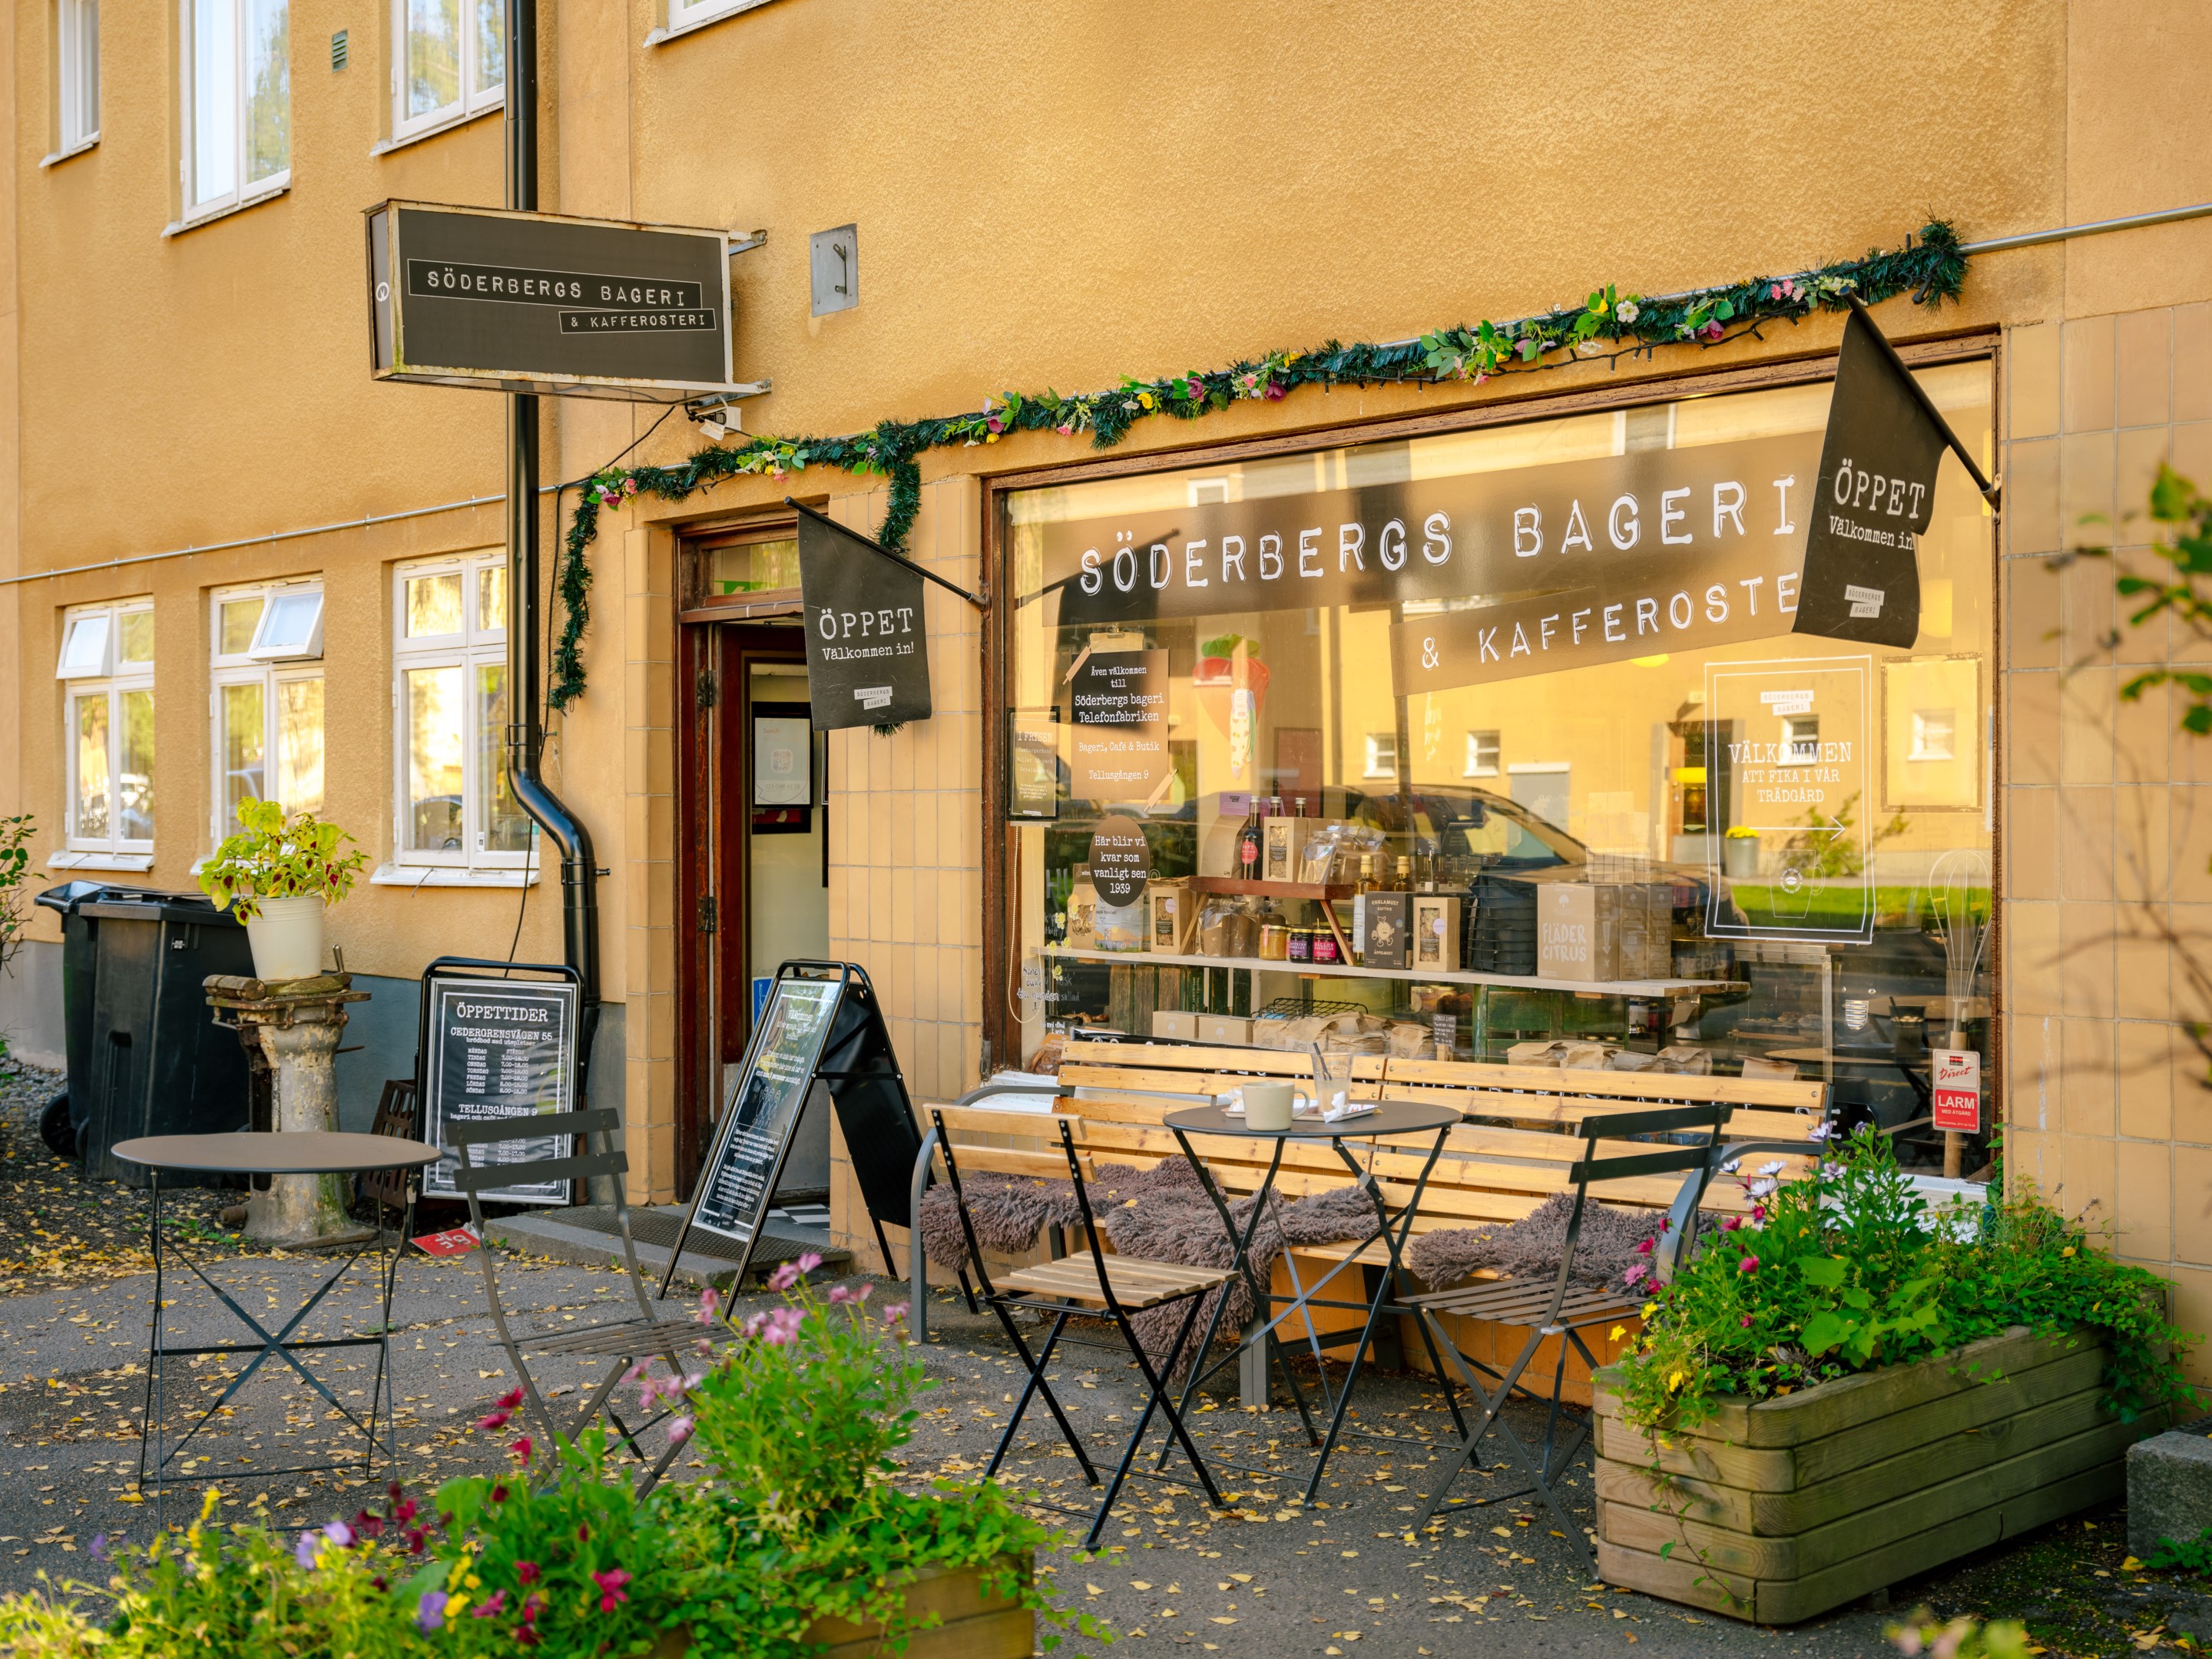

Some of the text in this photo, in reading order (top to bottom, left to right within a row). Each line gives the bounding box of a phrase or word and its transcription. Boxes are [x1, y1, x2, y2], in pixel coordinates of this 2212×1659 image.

[427, 267, 685, 307] SÖDERBERGS BAGERI
[571, 313, 706, 328] & KAFFEROSTERI
[1834, 458, 1926, 519] ÖPPET
[1080, 474, 1797, 596] SÖDERBERGS BAGERI
[1829, 515, 1896, 548] Välkommen
[1848, 588, 1882, 602] SÖDERBERGS
[1854, 605, 1877, 614] BAGERI
[820, 608, 913, 641] ÖPPET
[822, 641, 915, 661] Välkommen in!
[1422, 636, 1439, 671] &
[1091, 665, 1147, 677] Även välkommen
[1111, 679, 1127, 688] till
[857, 689, 889, 697] SÖDERBERGS
[1075, 693, 1164, 708] Söderbergs bageri
[867, 698, 886, 707] BAGERI
[1078, 711, 1160, 724] Telefonfabriken
[1018, 731, 1053, 743] I FRYSEN
[1078, 741, 1160, 754] Bageri, Café & Butik
[1727, 740, 1853, 765] VÄLKOMMEN
[1088, 770, 1149, 782] Tellusgången 9
[1742, 768, 1840, 783] ATT FIKA I VÅR
[1757, 786, 1824, 803] TRÄDGÅRD
[1094, 836, 1146, 847] Här blir vi
[1101, 852, 1140, 863] kvar som
[1094, 867, 1147, 881] vanligt sen
[1110, 883, 1131, 894] 1939
[1542, 922, 1587, 945] FLÄDER
[1542, 945, 1587, 962] CITRUS
[456, 1002, 548, 1022] ÖPPETTIDER
[450, 1026, 553, 1041] CEDERGRENSVÄGEN 55
[1939, 1065, 1974, 1081] Direct
[459, 1104, 538, 1116] TELLUSGÅNGEN 9
[1938, 1095, 1975, 1110] LARM
[450, 1113, 470, 1121] bageri
